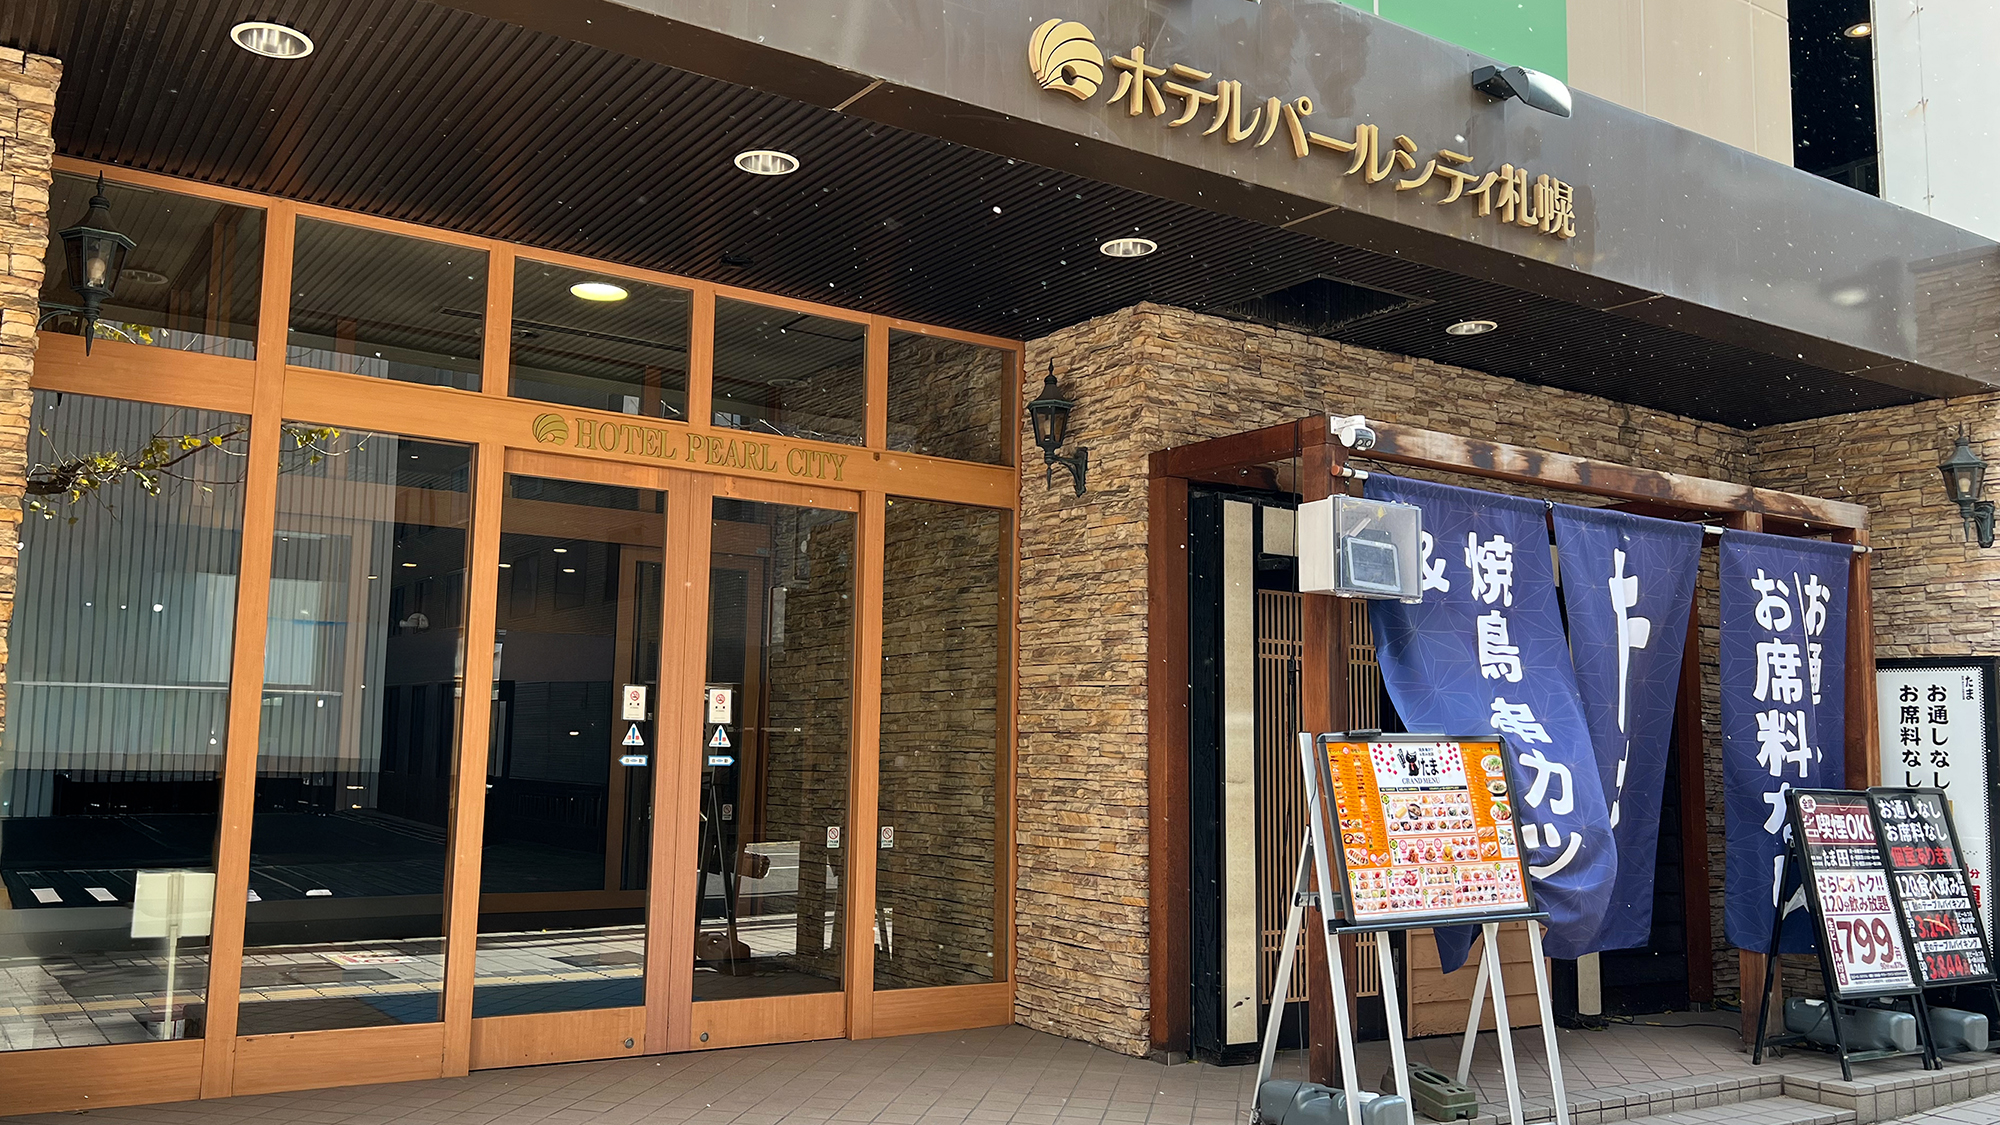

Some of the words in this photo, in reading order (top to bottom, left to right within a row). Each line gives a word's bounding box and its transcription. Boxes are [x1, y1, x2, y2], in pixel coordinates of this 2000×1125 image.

[1105, 45, 1577, 240] ホテルパールシティ札幌
[575, 418, 680, 461] HOTEL
[686, 432, 779, 474] PEARL
[786, 448, 849, 482] CITY
[1965, 675, 1975, 701] たま
[1899, 684, 1922, 788] お席料なし
[1926, 684, 1951, 790] お通しなし
[1420, 757, 1440, 777] たま
[1401, 777, 1423, 786] GRAND
[1423, 777, 1440, 785] MENU
[1878, 799, 1942, 820] お通しなし
[1884, 821, 1948, 843] お席料なし
[1890, 846, 1954, 868] 個室あります
[1822, 894, 1891, 913] 120分飲み放題
